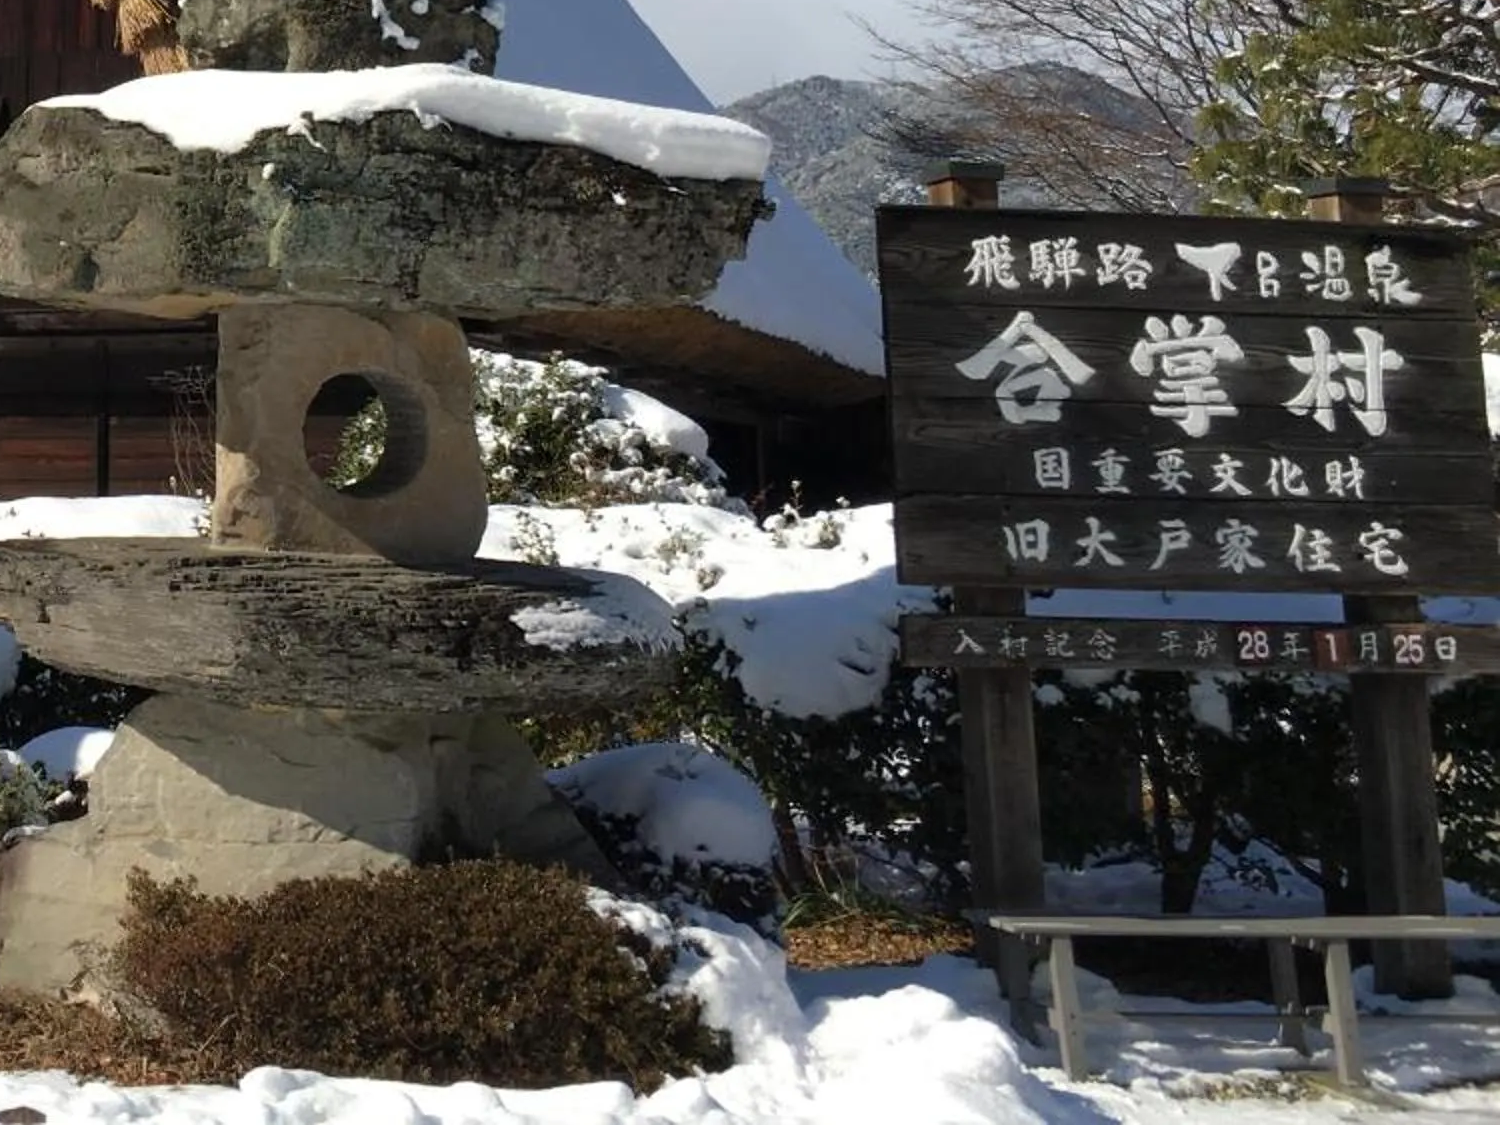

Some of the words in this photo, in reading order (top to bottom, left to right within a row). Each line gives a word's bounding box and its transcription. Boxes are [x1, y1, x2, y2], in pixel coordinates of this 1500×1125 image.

[955, 310, 1405, 438] 合掌村
[1033, 446, 1364, 499] 国重要文化財
[1004, 518, 1408, 576] 旧大戸家住宅
